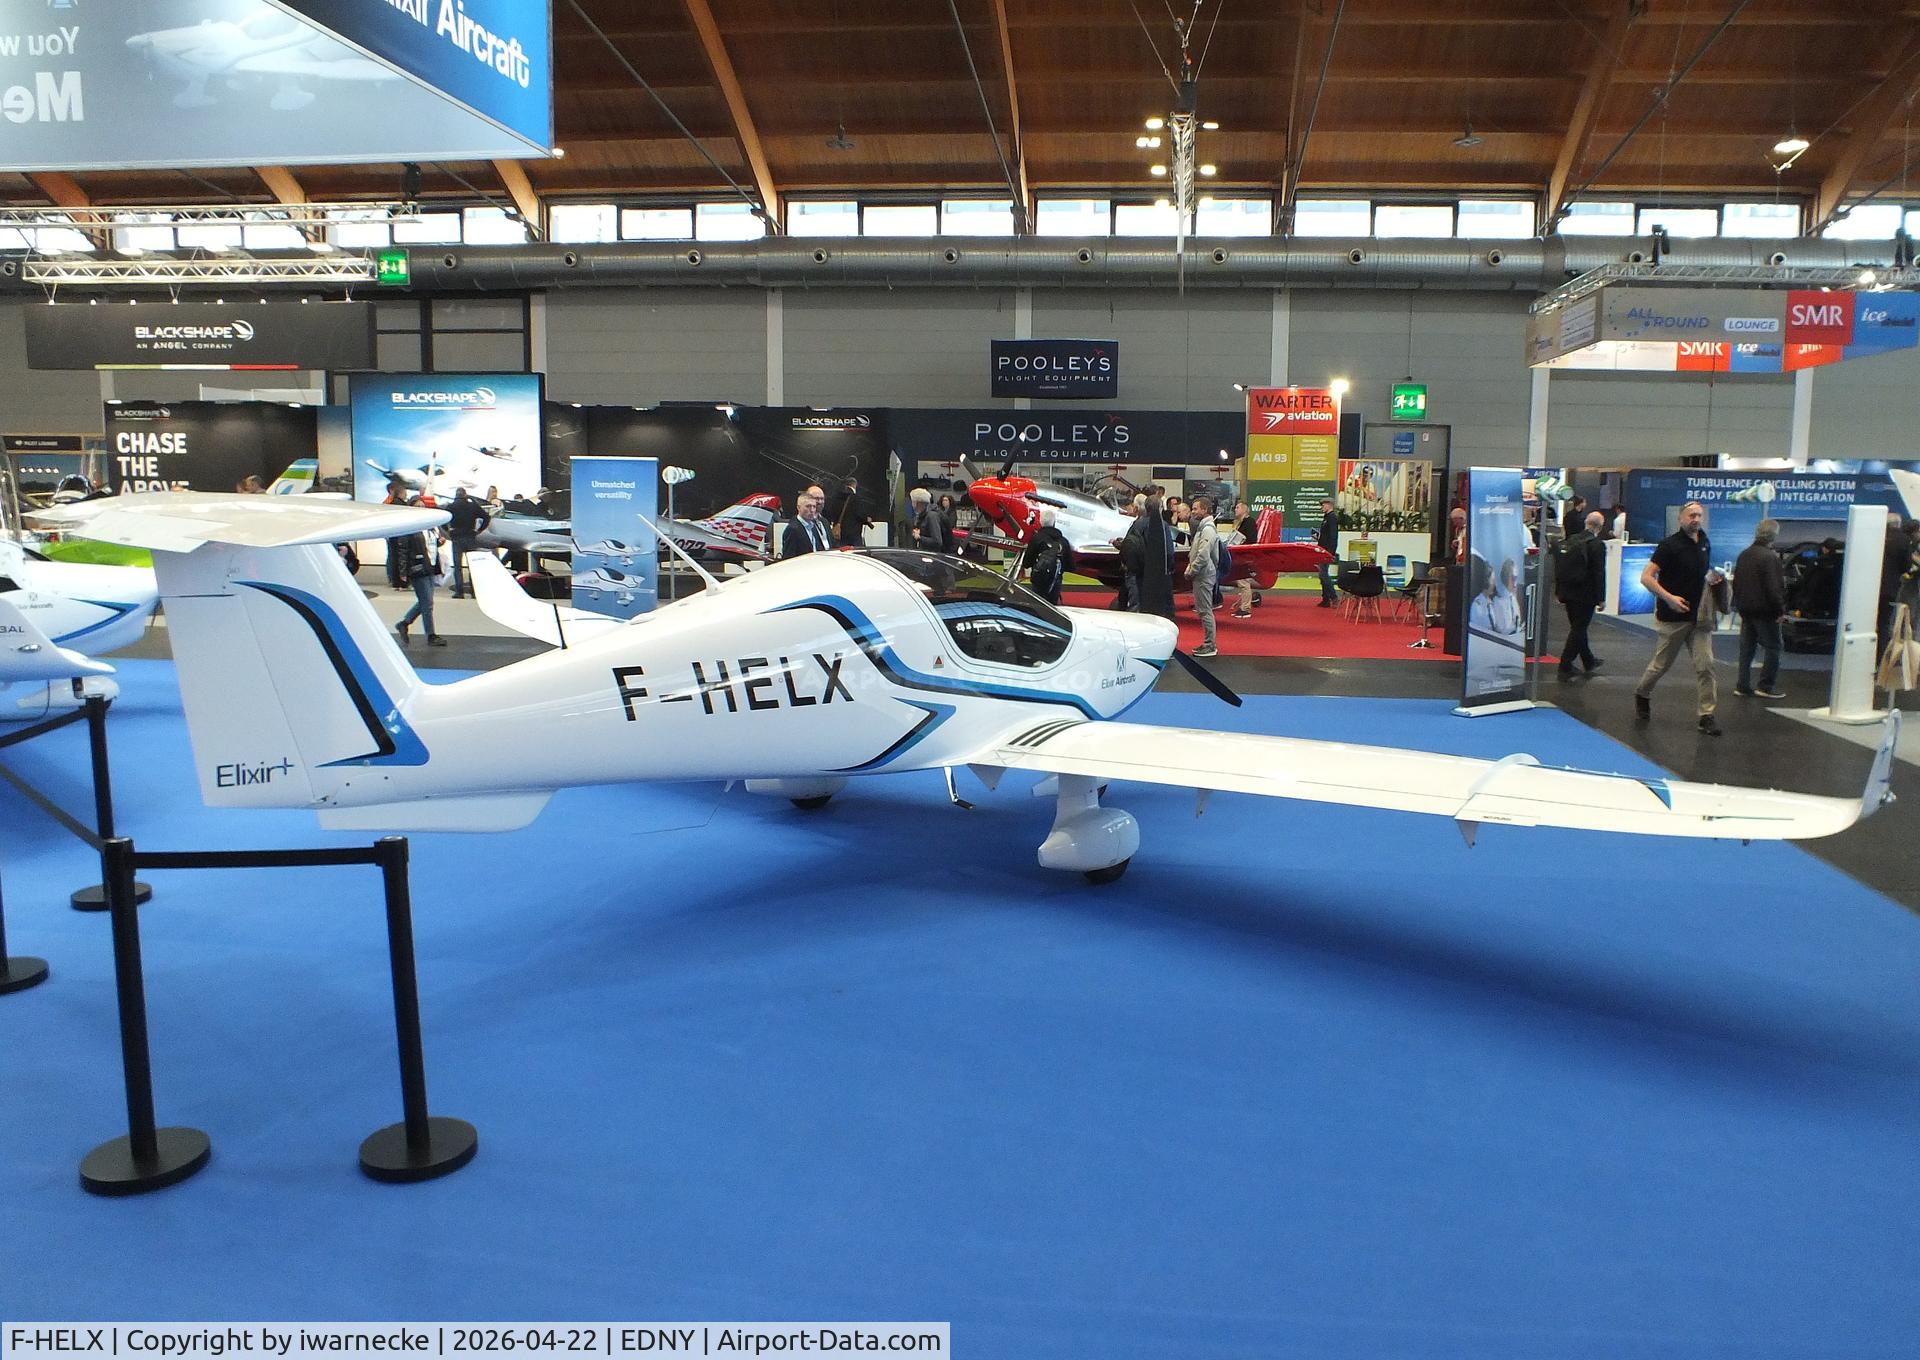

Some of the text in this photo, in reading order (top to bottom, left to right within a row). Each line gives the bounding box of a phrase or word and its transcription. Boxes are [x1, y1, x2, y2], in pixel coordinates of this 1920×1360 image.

[436, 0, 530, 88] Aircraft
[1628, 307, 1654, 319] ALL
[1792, 305, 1844, 326] SMR
[1861, 308, 1888, 322] ice
[1653, 316, 1710, 328] ROUND
[1728, 320, 1775, 330] LOUNGE
[135, 326, 233, 338] BLACKSHAPE
[998, 356, 1111, 371] POOLEYS
[391, 392, 477, 404] BLACKSHAPE
[1256, 395, 1333, 409] WARTER
[792, 417, 857, 426] BLACKSHAPE
[1287, 410, 1333, 421] aviation
[974, 423, 1130, 444] POOLEYS
[116, 432, 188, 454] CHASE
[974, 449, 1130, 458] FLIGT EQUIPMENT
[1252, 453, 1288, 463] AKI 93
[117, 456, 159, 477] THE
[591, 480, 636, 489] Unmatched
[1687, 477, 1750, 488] TURBULENCE
[1818, 480, 1856, 490] SYSTEM
[1254, 495, 1283, 503] AVGAS
[1687, 490, 1722, 500] READY
[1780, 492, 1855, 503] INTEGRATION
[611, 652, 855, 722] F-HELX
